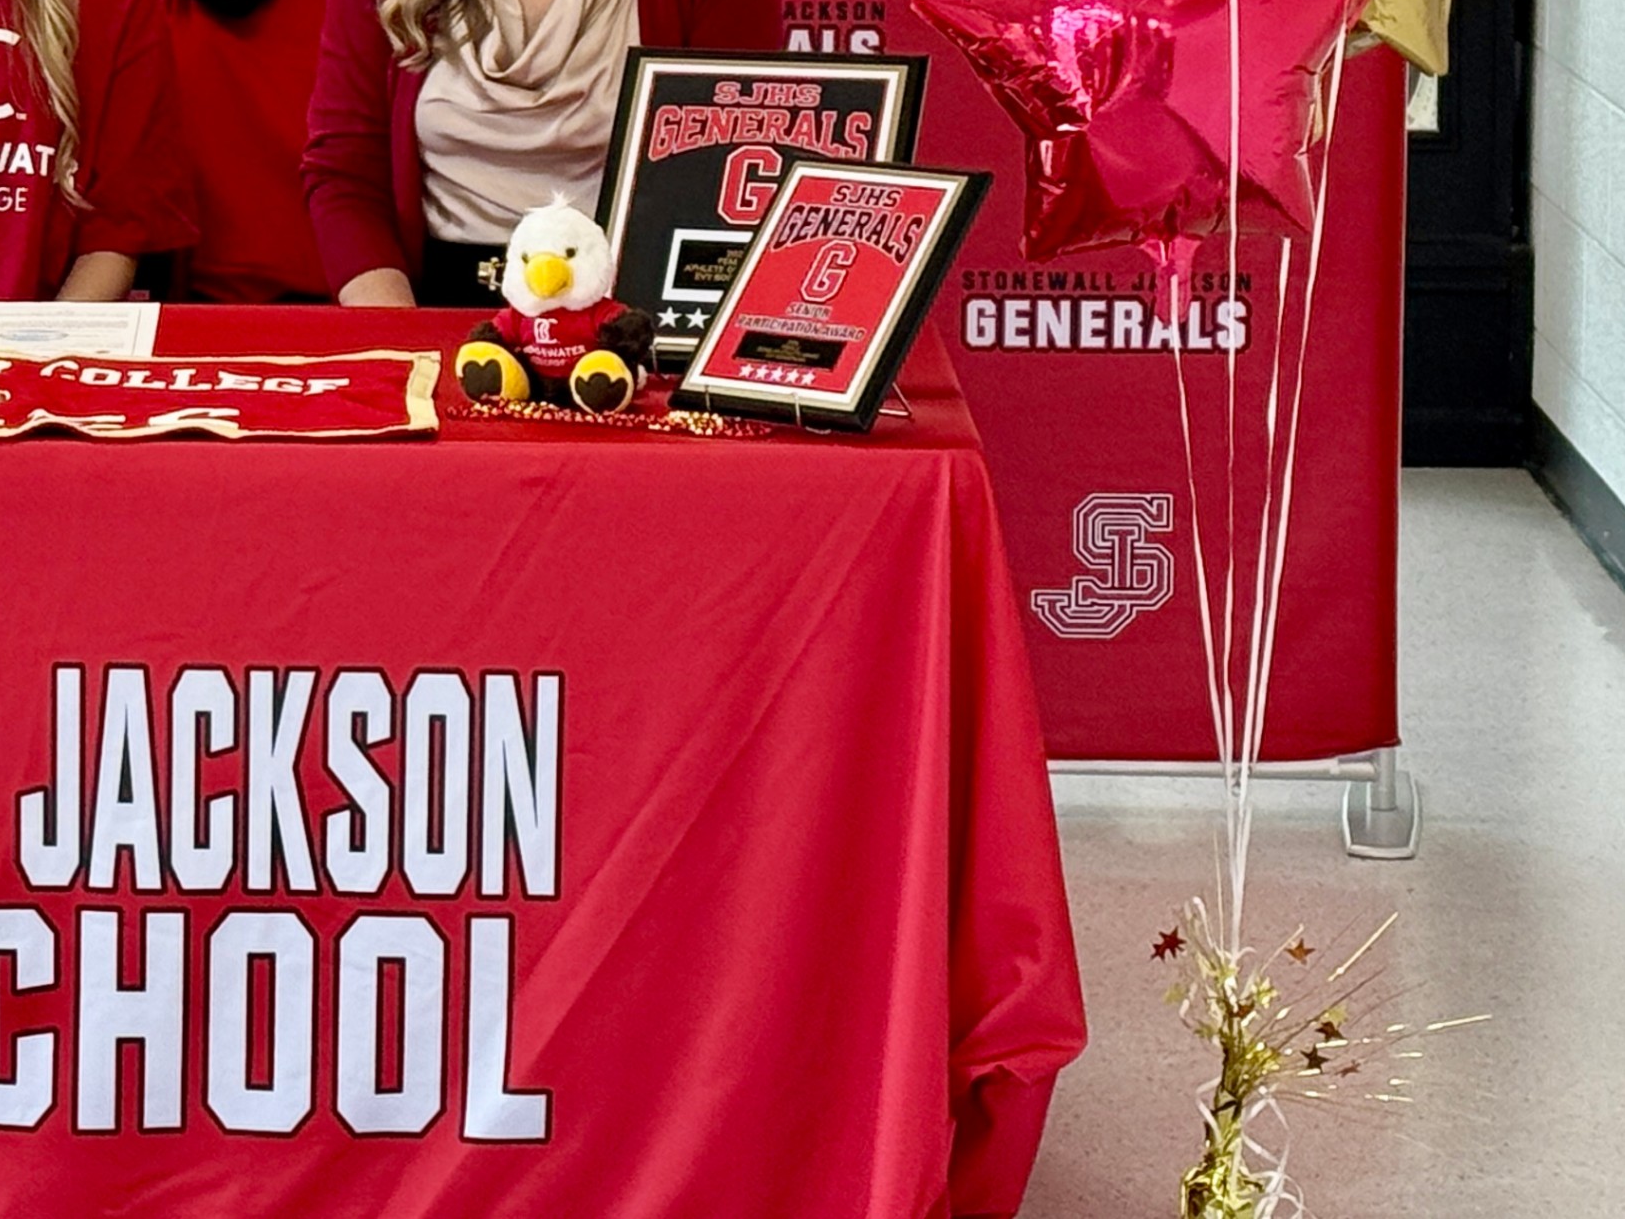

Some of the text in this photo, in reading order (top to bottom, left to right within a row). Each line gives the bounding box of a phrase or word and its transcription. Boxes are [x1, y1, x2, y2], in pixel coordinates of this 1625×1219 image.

[784, 1, 885, 20] ACKSON
[713, 81, 821, 107] SJHS
[648, 105, 872, 162] GENERALS
[717, 146, 782, 225] G
[833, 184, 903, 208] SJHS
[771, 203, 925, 265] GENERALS
[801, 240, 856, 301] G
[962, 270, 1117, 291] STONEWALL
[787, 303, 832, 318] SENIOR
[737, 314, 821, 336] PARTICIPATION
[17, 663, 565, 899] JACKSON
